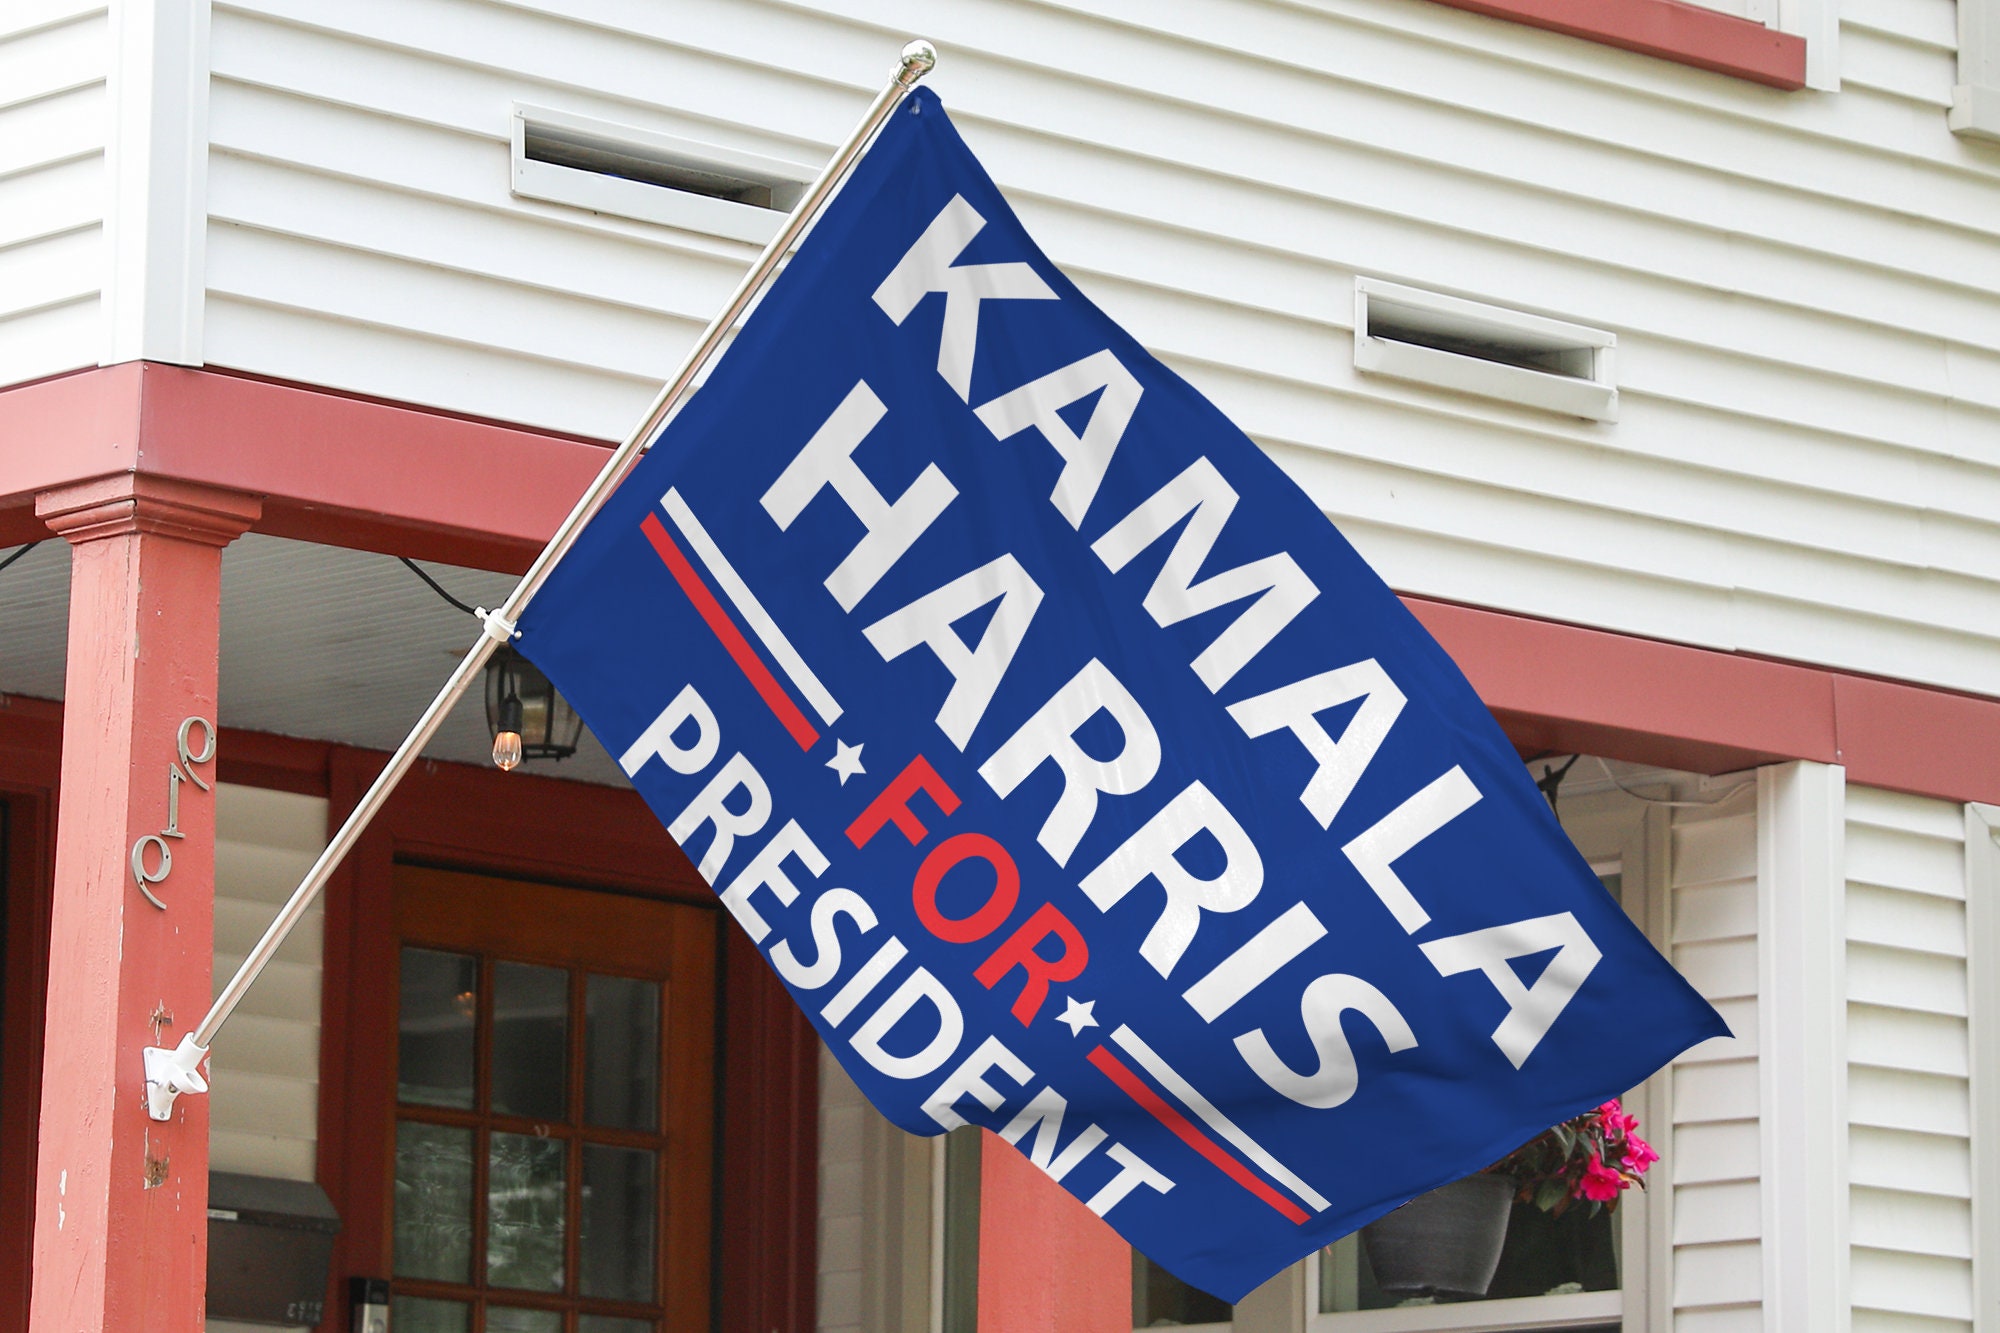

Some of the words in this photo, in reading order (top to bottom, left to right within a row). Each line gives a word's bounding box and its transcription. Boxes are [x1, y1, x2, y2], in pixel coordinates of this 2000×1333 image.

[759, 379, 1419, 1109] HARRIS
[844, 754, 1089, 1028] FOR
[872, 193, 1603, 1070] KAMALA
[619, 683, 1177, 1219] PRESIDENT
